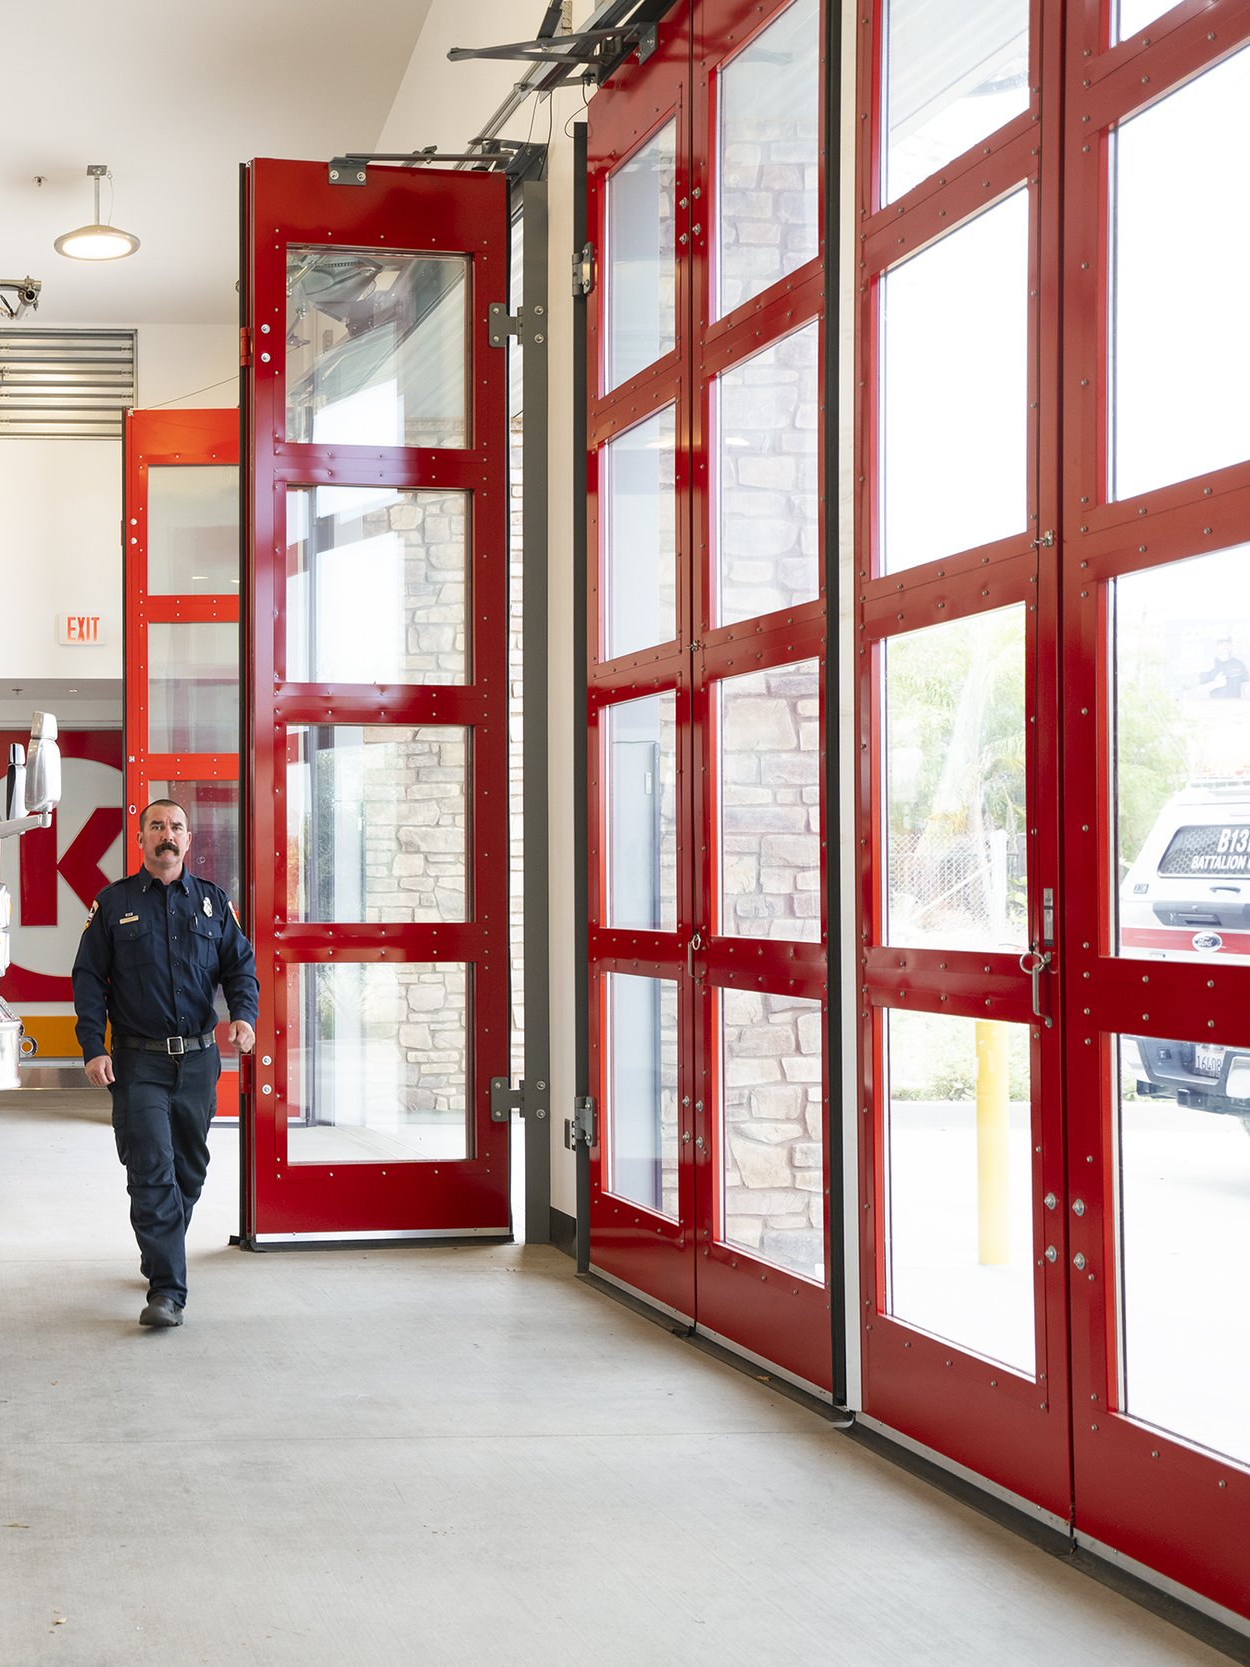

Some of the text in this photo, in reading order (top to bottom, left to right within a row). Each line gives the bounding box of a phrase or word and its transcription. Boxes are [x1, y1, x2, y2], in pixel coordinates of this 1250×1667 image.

[67, 616, 100, 641] EXIT
[1217, 828, 1250, 853] B13
[19, 807, 123, 926] K
[1191, 855, 1247, 870] BATTALION
